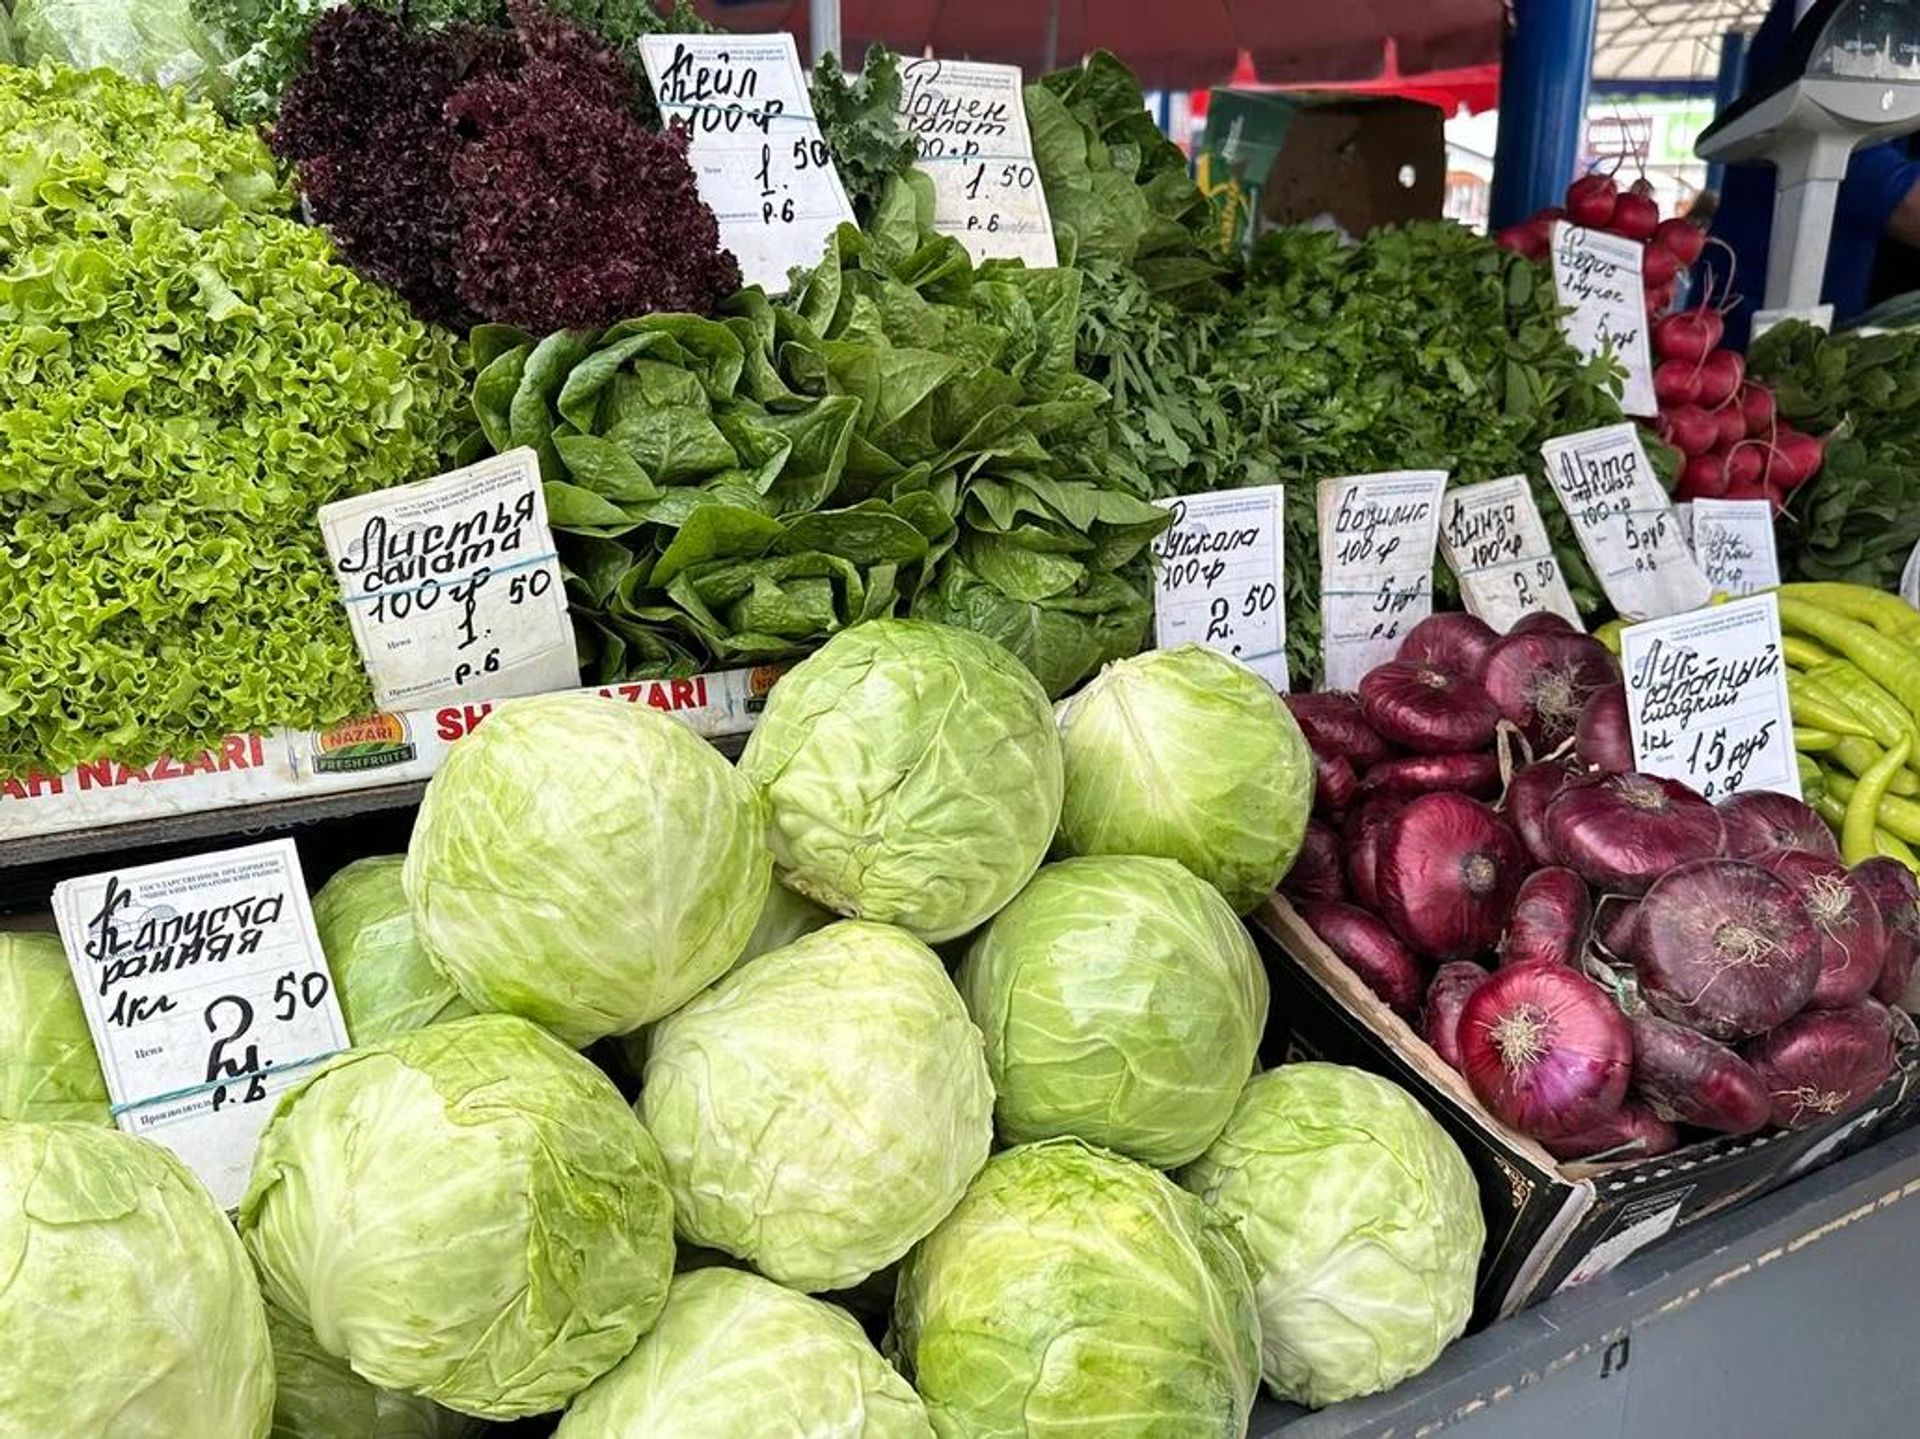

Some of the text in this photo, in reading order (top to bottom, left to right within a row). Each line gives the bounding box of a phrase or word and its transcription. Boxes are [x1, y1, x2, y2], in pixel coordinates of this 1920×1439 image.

[660, 43, 757, 103] Кейл
[793, 137, 831, 169] 50
[1000, 164, 1034, 188] 50
[1561, 449, 1636, 492] Мята
[338, 491, 535, 572] Листья
[1154, 500, 1259, 559] Руккола
[1449, 498, 1515, 548] Кинза
[363, 528, 521, 592] салата
[1536, 561, 1554, 588] 50
[509, 570, 551, 605] 50
[1243, 583, 1276, 617] 50
[1641, 689, 1739, 730] сладкий
[330, 727, 394, 746] NAZARI
[85, 876, 284, 962] Капуста
[100, 929, 263, 997] ранняя
[273, 971, 329, 1022] 50
[135, 1044, 164, 1060] Цена
